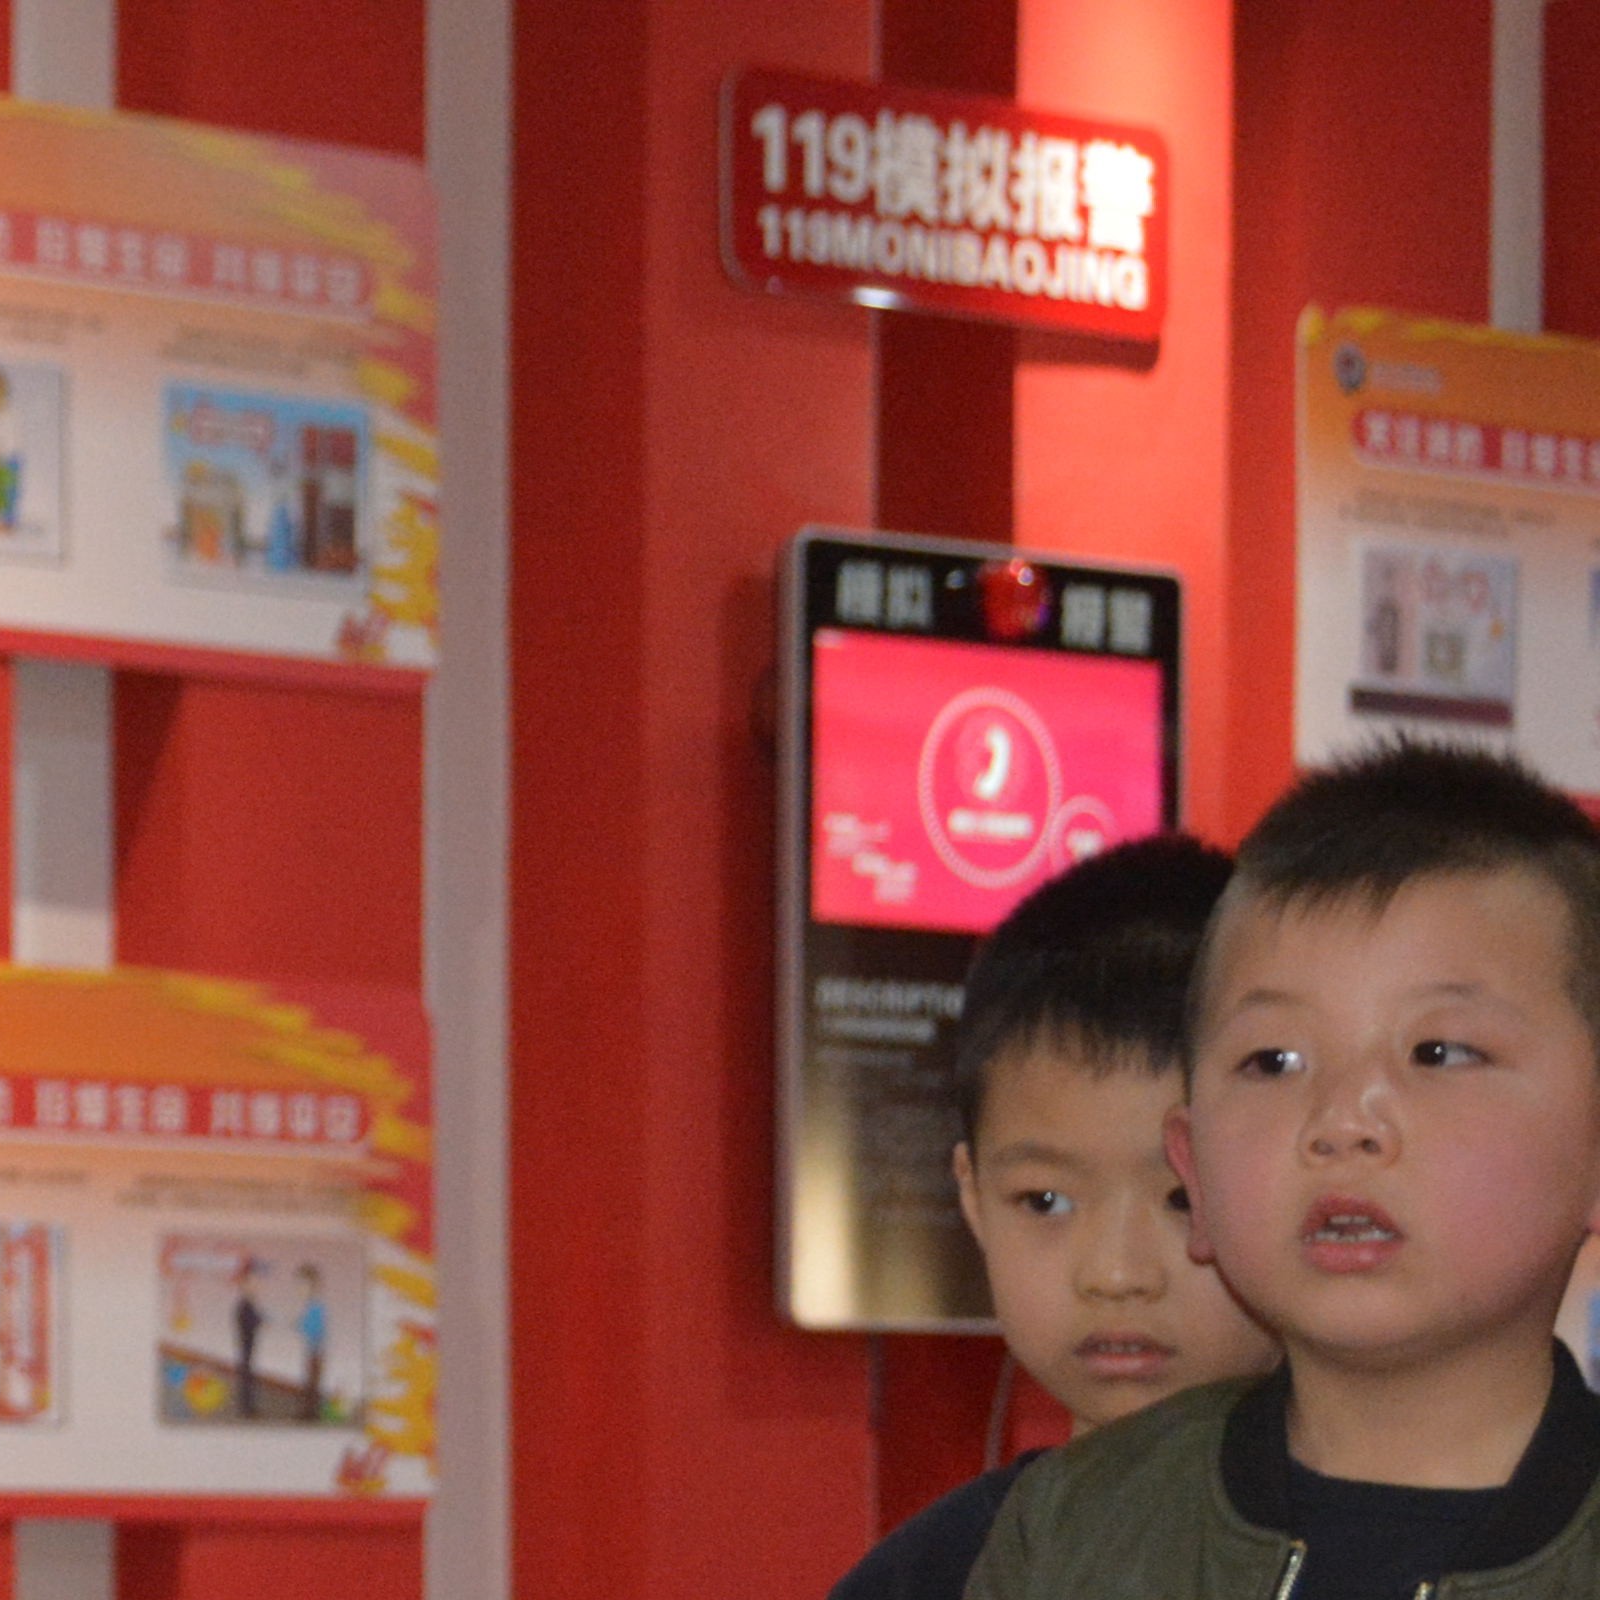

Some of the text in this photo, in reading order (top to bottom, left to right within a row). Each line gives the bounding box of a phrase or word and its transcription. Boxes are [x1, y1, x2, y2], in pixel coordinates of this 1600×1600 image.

[751, 105, 1155, 254] 119模拟报警
[757, 205, 1149, 311] 119MONIBAOJING
